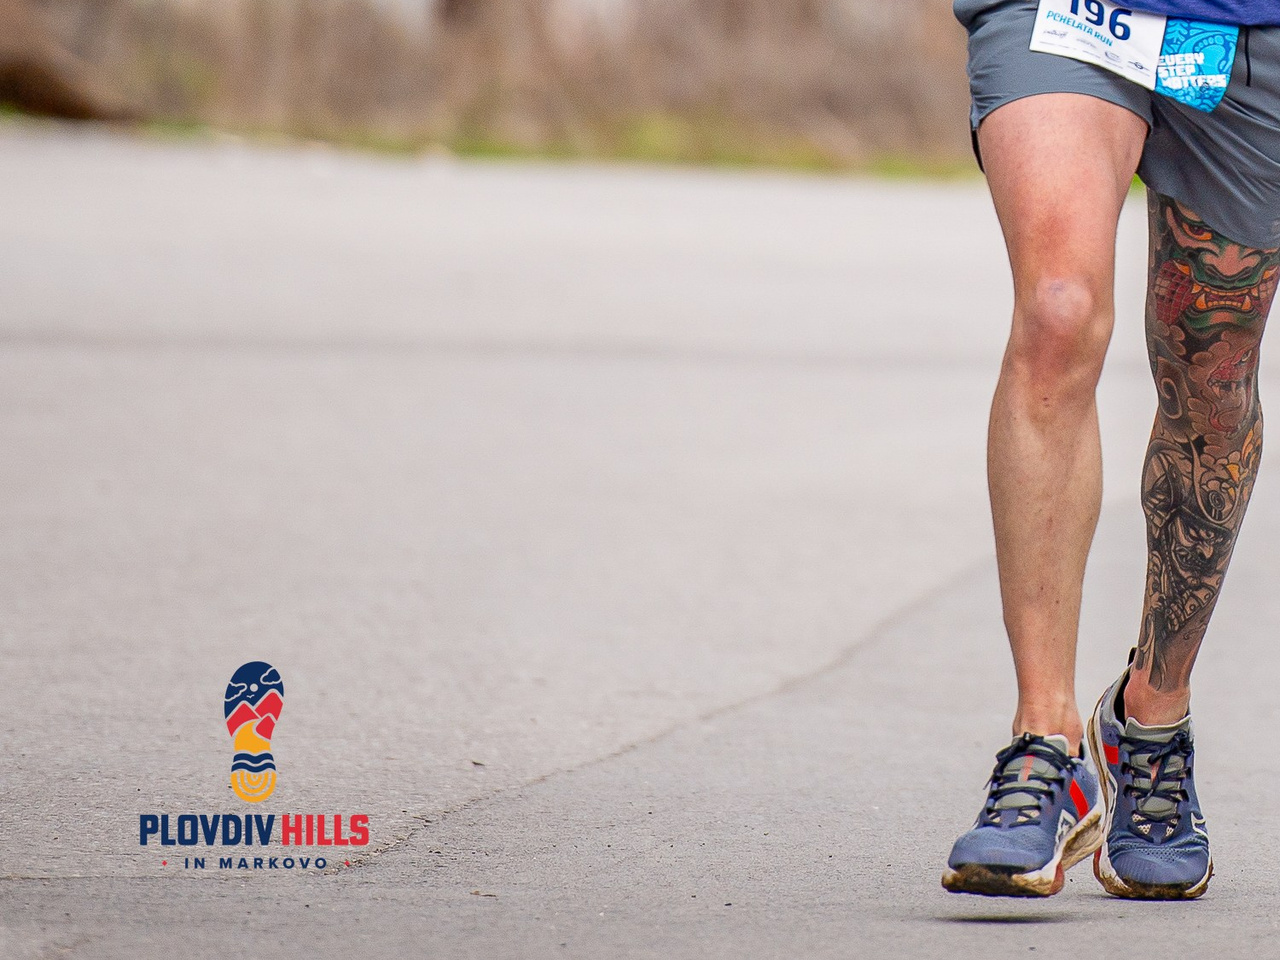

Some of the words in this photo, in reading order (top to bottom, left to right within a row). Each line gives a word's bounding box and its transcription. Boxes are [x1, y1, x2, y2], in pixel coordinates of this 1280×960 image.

[1046, 10, 1093, 36] PCHELATA
[1094, 31, 1114, 47] RUN
[1157, 64, 1196, 77] STEP
